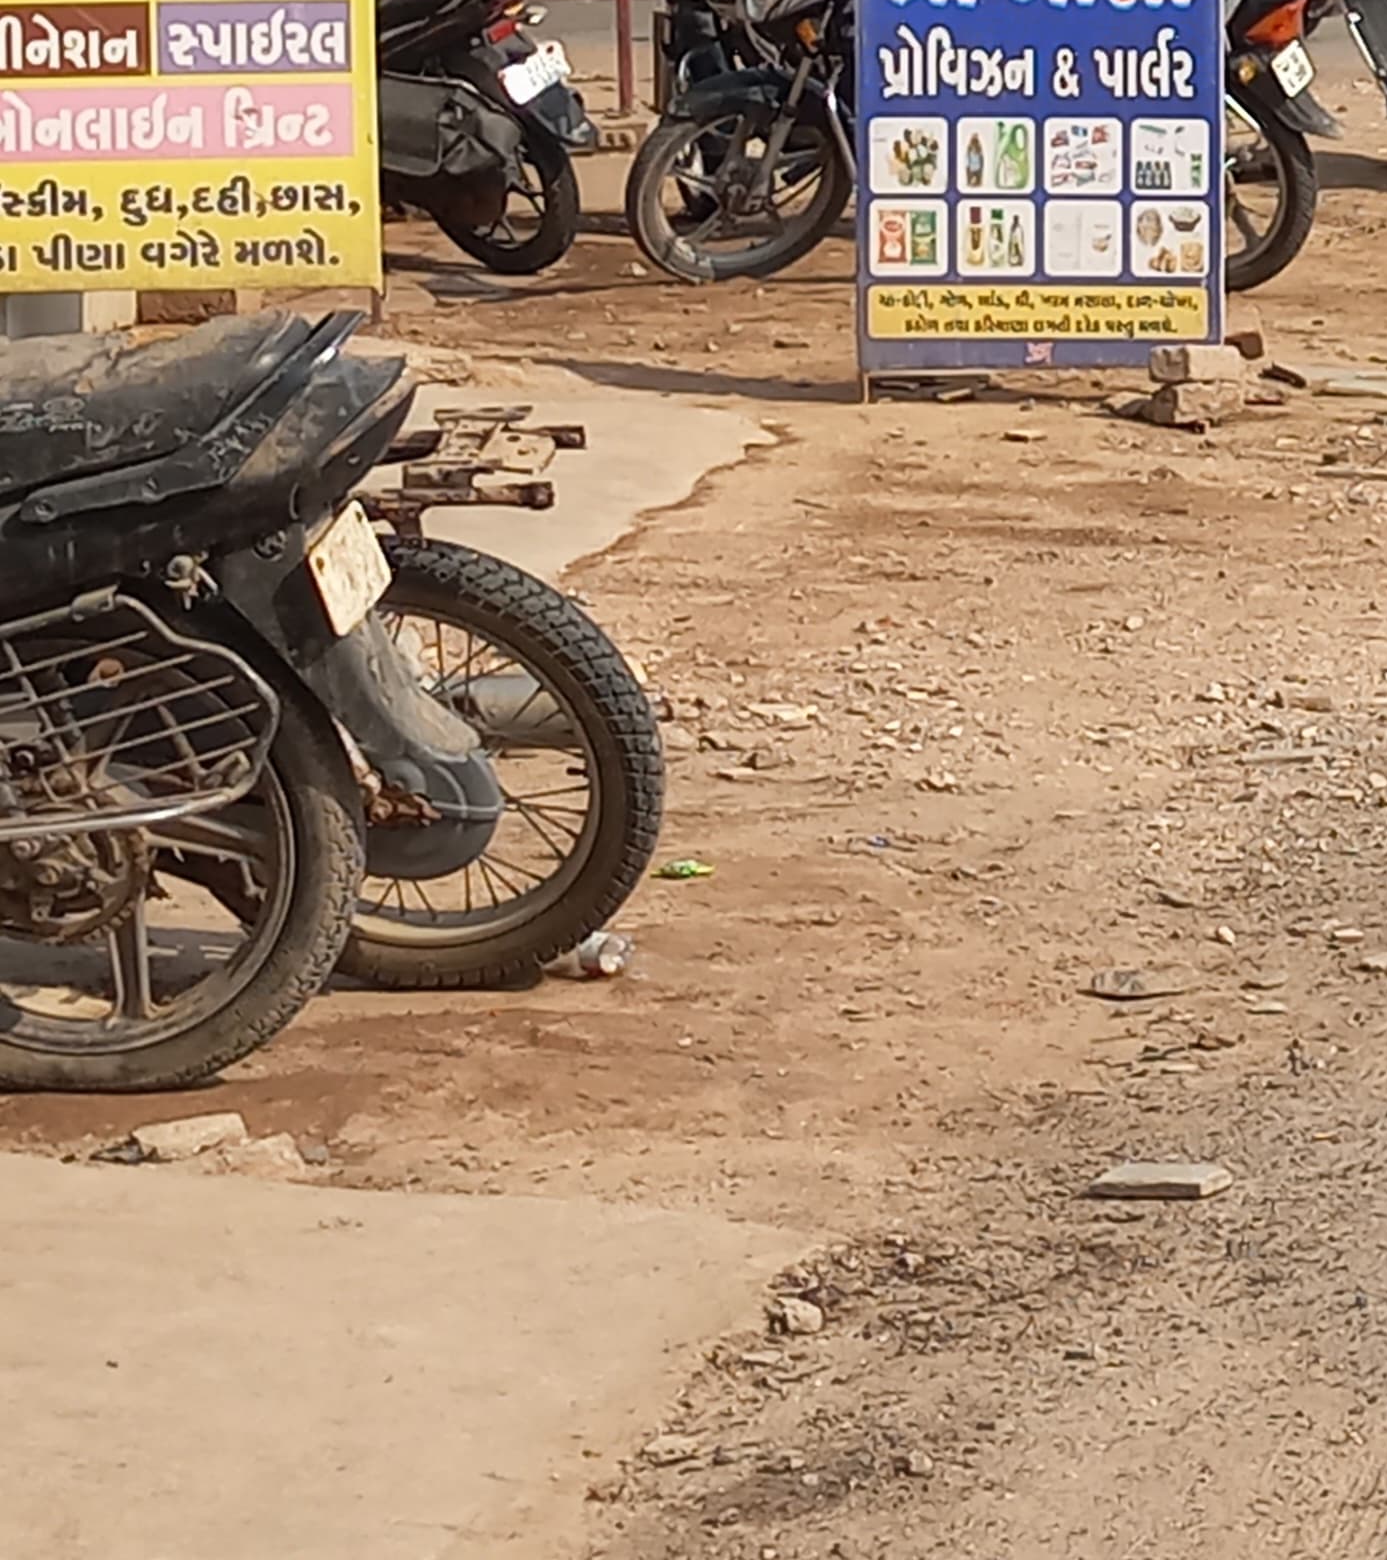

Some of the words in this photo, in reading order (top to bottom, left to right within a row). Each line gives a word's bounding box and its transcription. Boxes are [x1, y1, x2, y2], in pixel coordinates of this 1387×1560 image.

[878, 25, 1035, 98] પ્રોવિઝન
[1053, 48, 1081, 97] &
[1092, 28, 1196, 98] પાર્લર
[33, 234, 126, 272] પીણા
[140, 230, 222, 270] વગેરે
[234, 229, 341, 269] મળશે.
